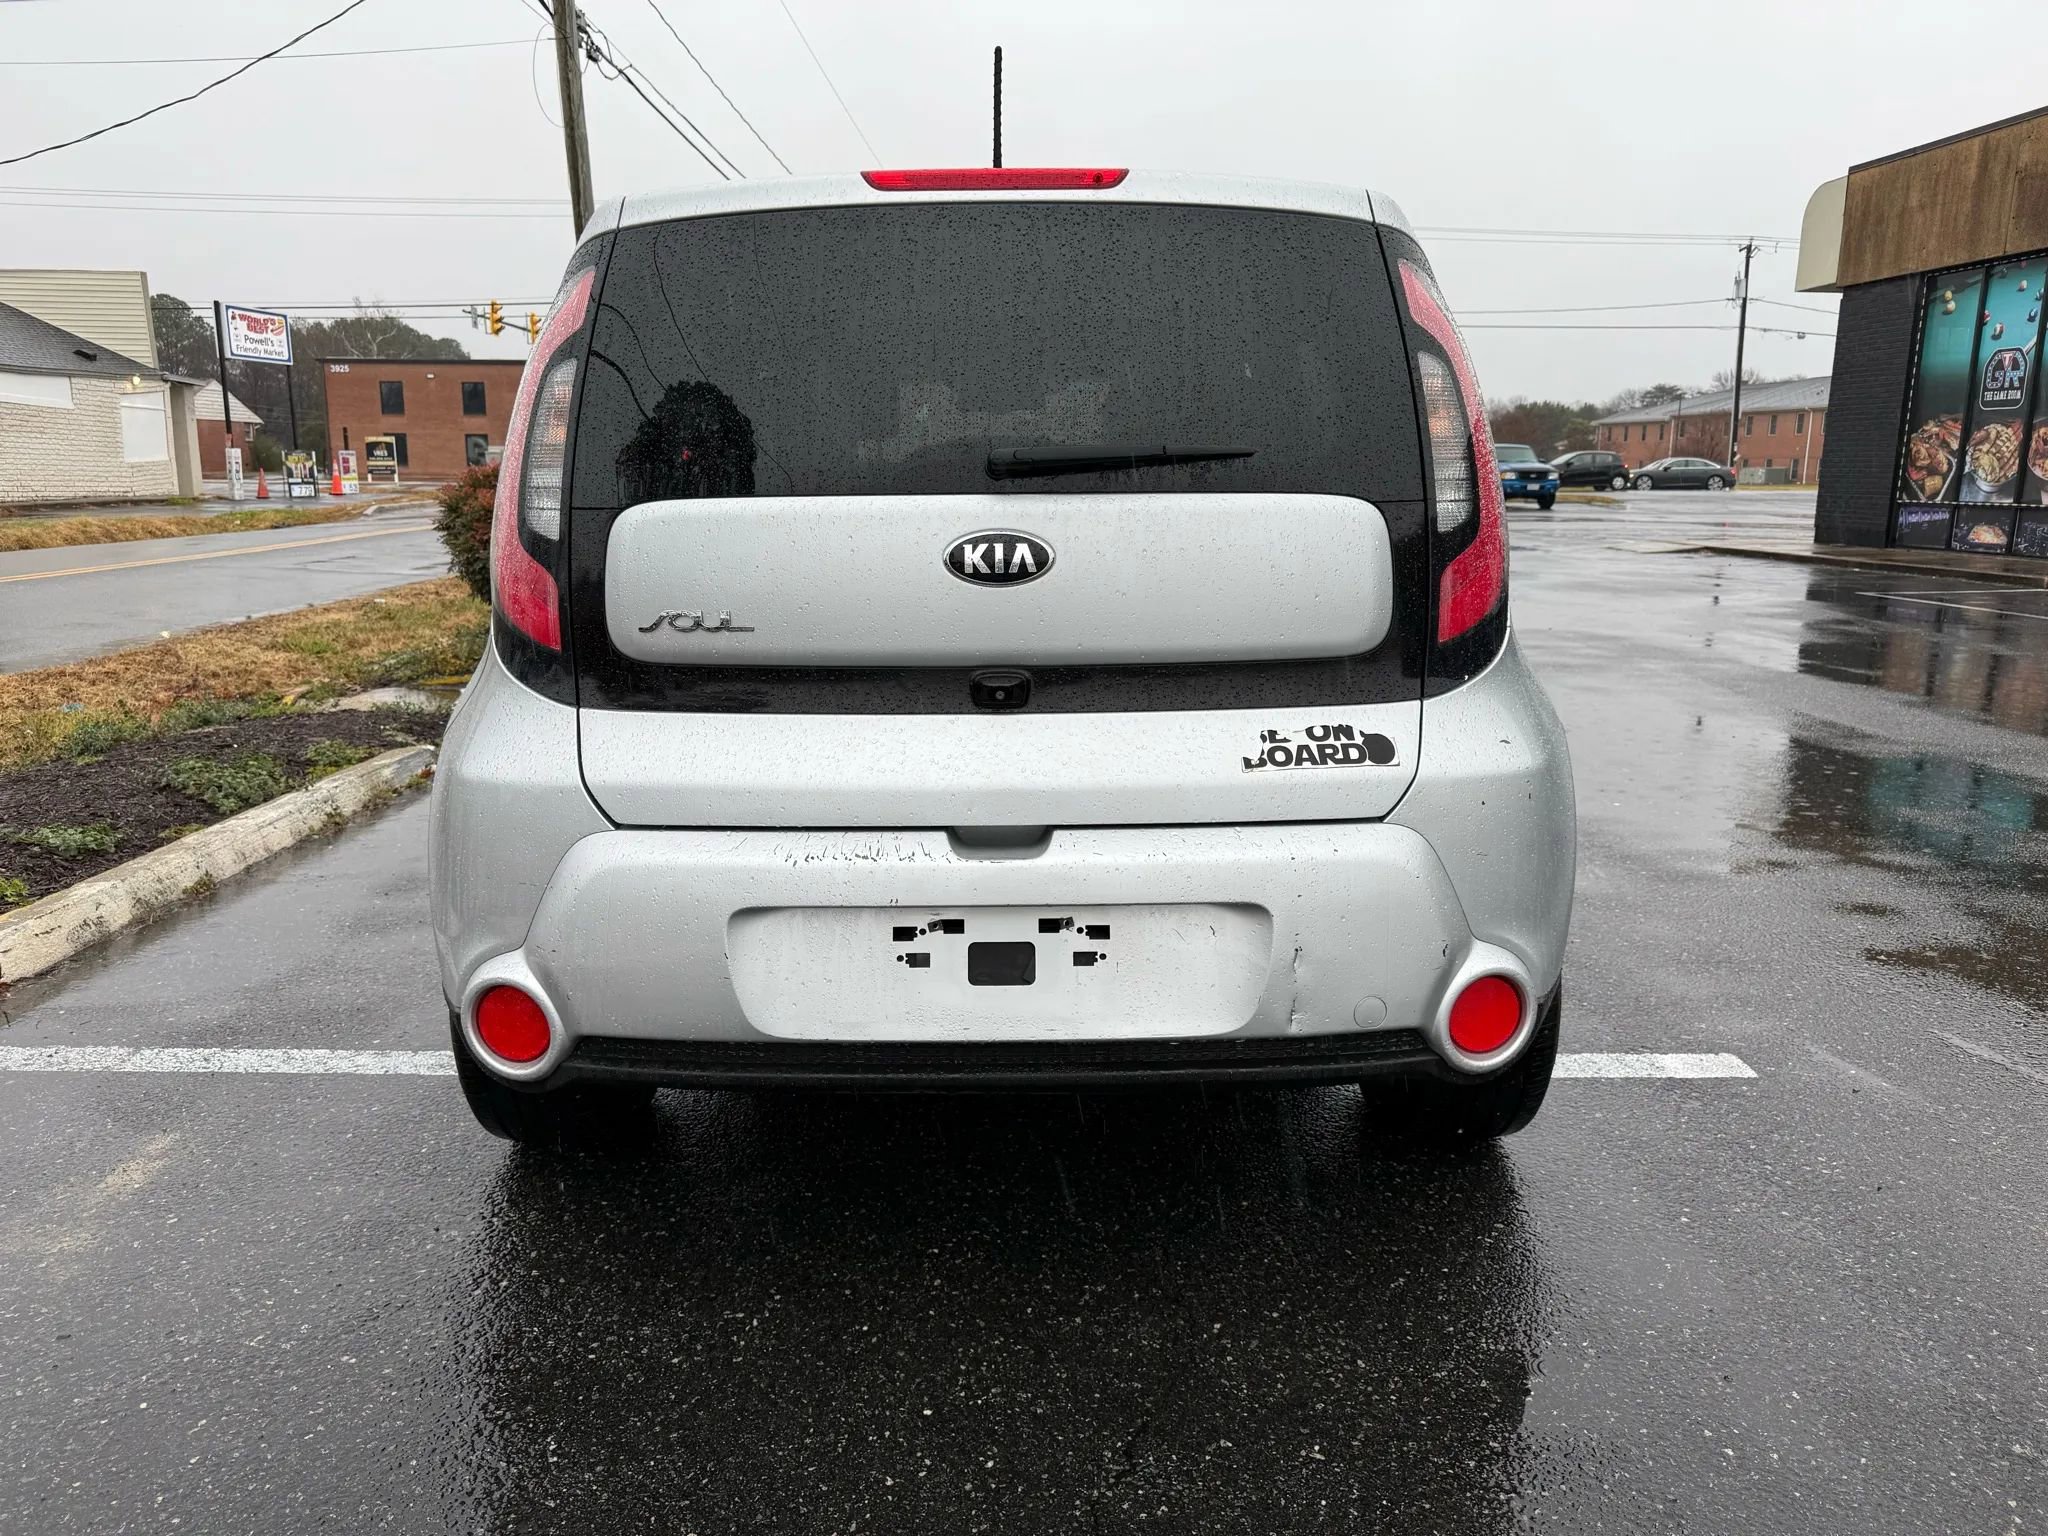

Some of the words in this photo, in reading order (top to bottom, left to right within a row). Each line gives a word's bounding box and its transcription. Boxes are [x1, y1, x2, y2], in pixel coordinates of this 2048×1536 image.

[244, 334, 275, 347] Powell's
[235, 344, 262, 355] Friendly
[263, 347, 285, 358] Market
[330, 364, 350, 373] 3925
[1984, 391, 1993, 401] THE
[962, 543, 1037, 574] KIA
[1305, 724, 1356, 742] ON
